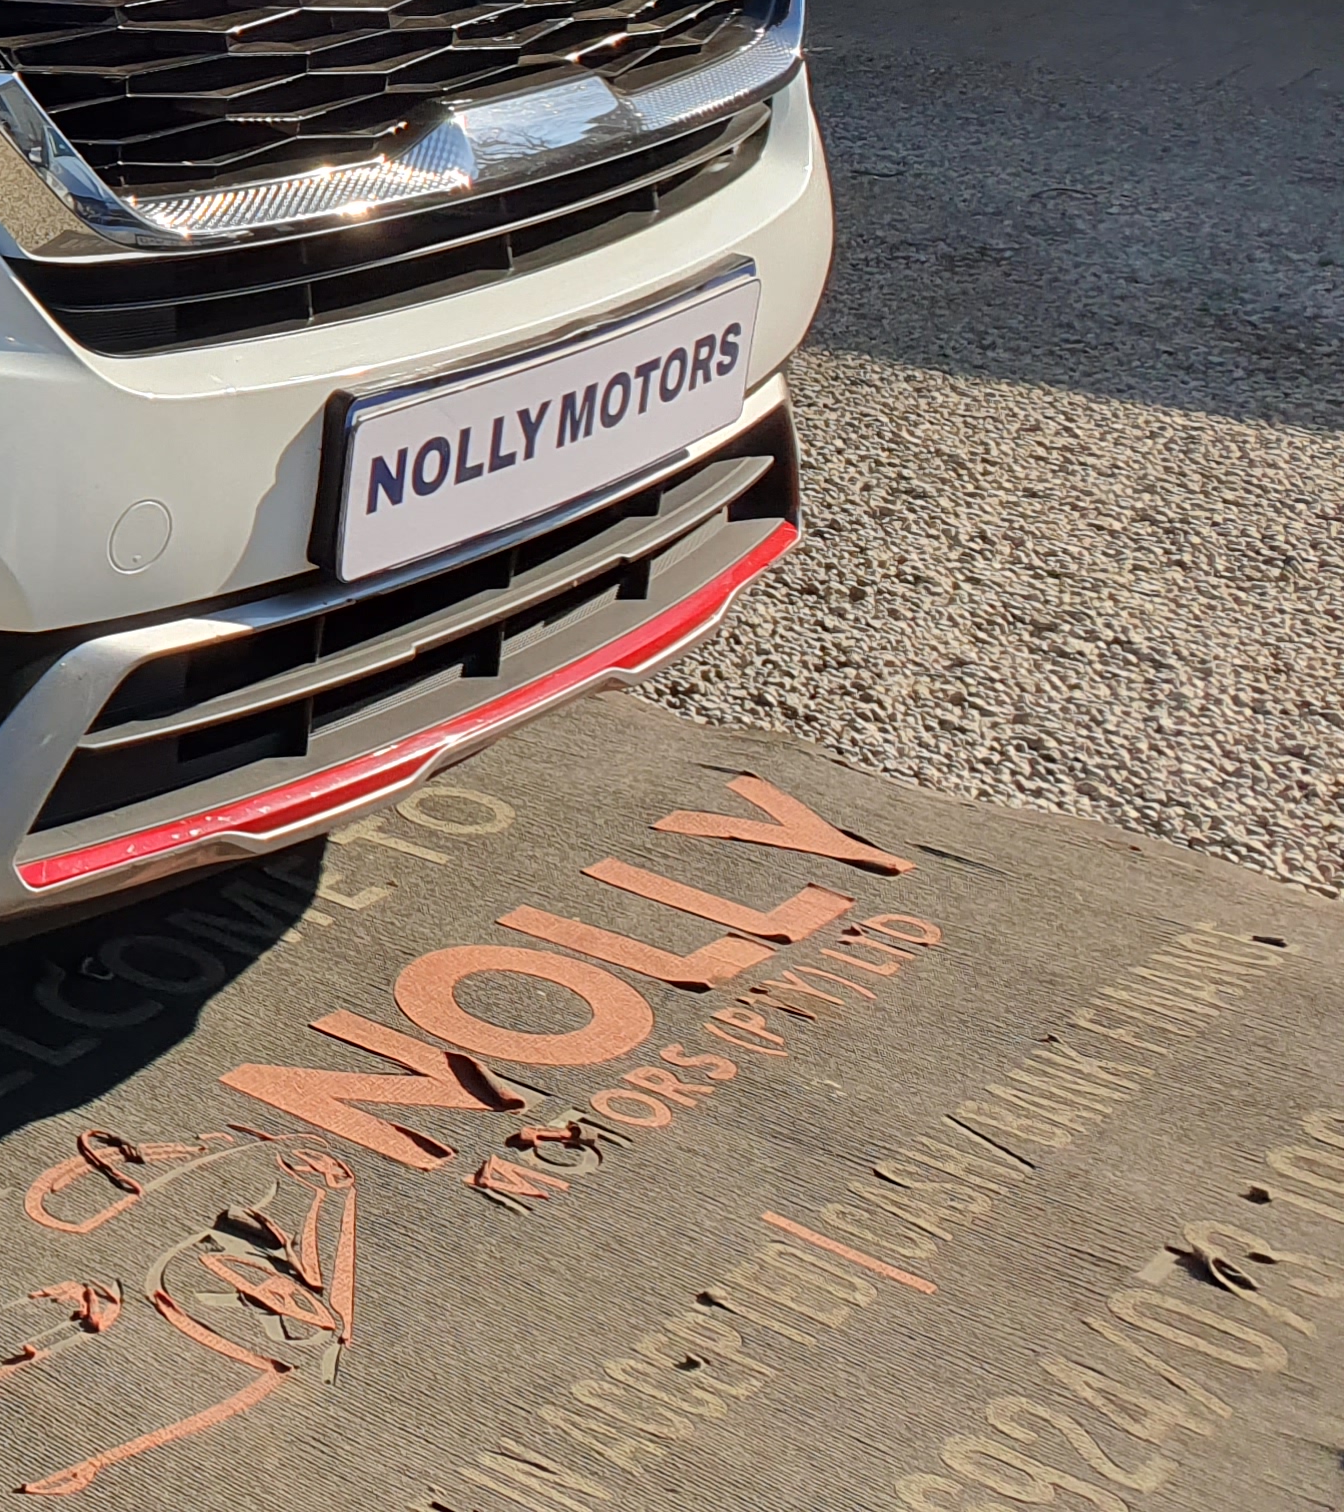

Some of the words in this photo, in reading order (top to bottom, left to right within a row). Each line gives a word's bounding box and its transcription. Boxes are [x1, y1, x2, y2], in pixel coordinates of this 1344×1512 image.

[365, 400, 552, 516] NOLLY
[555, 321, 742, 450] MOTORS
[322, 785, 516, 866] TO
[219, 772, 917, 1172] NOLLY
